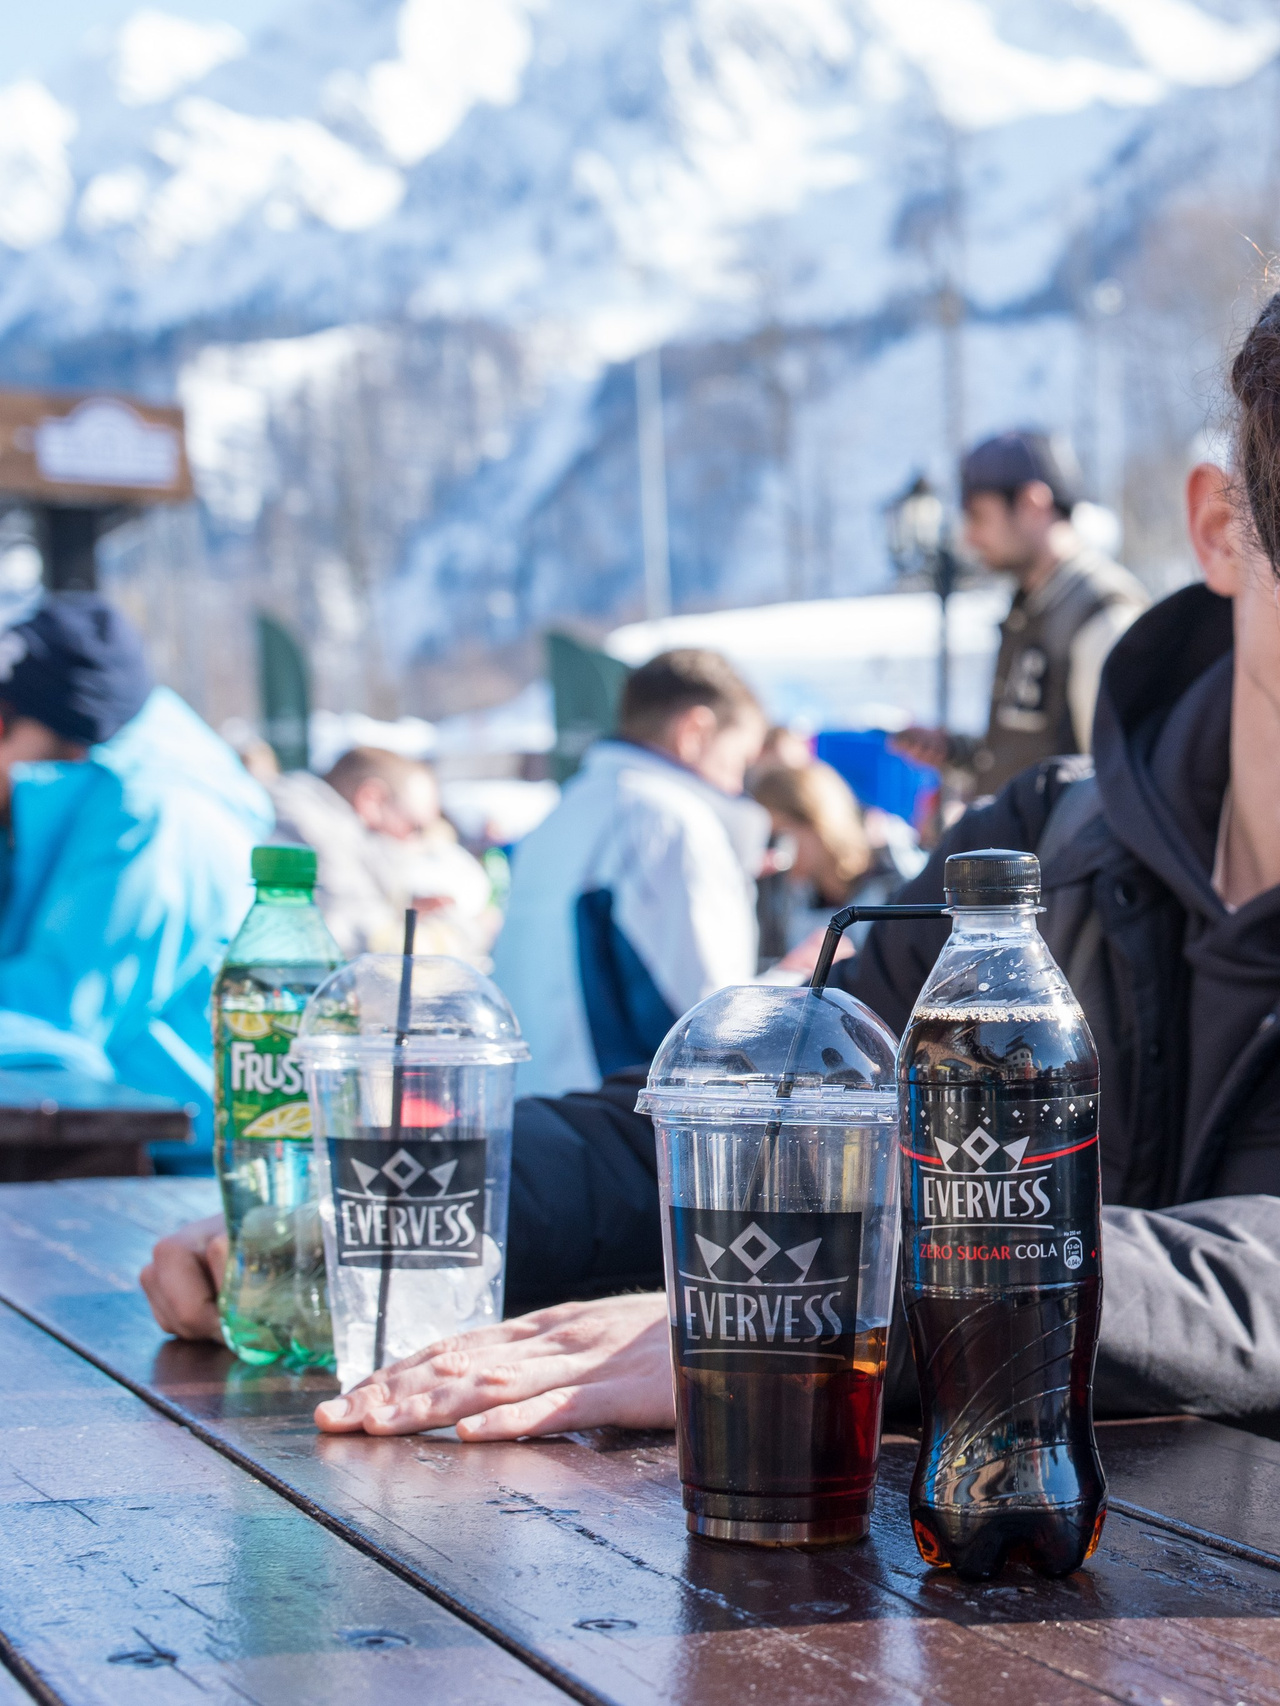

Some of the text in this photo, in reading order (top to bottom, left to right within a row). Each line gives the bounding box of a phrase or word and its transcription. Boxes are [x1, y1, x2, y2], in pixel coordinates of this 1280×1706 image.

[231, 1041, 346, 1095] FRUS
[923, 1176, 1051, 1218] EVERVESS
[341, 1201, 477, 1247] EVERVESS
[920, 1243, 1058, 1260] ZERO SUGAR COLA
[683, 1286, 843, 1345] EVERVESS
